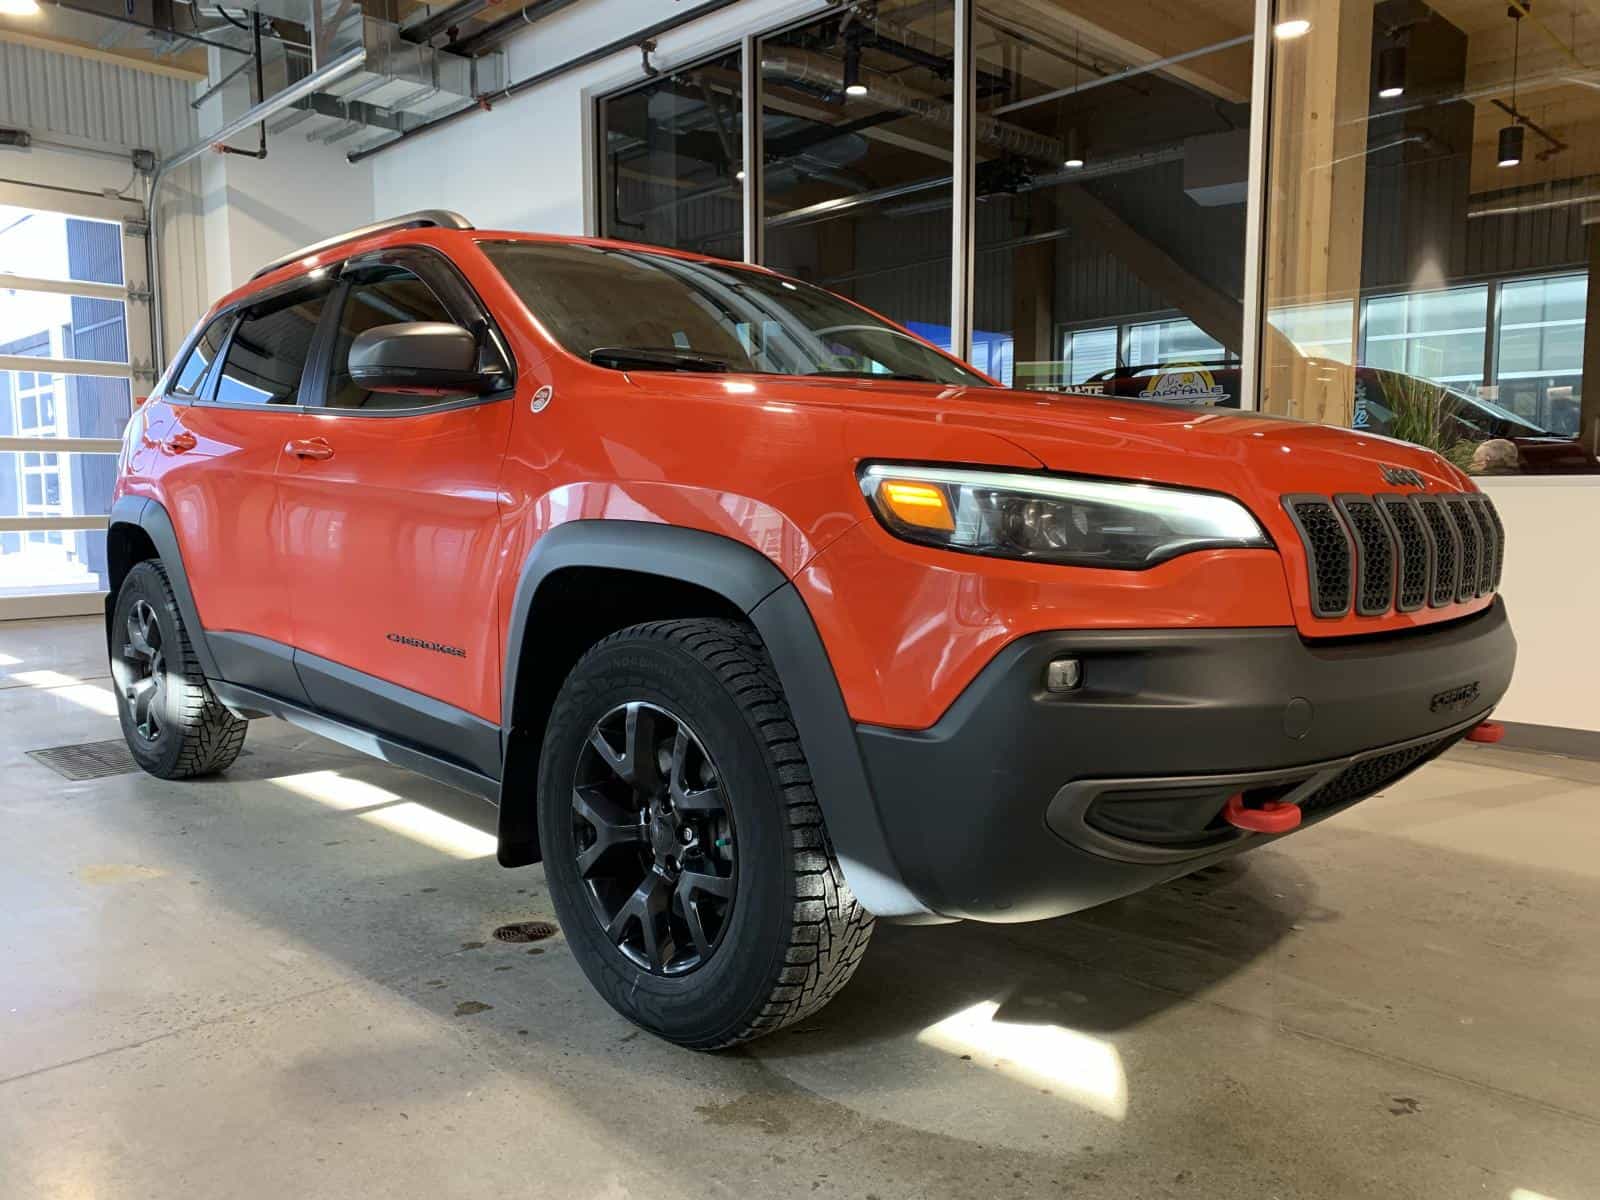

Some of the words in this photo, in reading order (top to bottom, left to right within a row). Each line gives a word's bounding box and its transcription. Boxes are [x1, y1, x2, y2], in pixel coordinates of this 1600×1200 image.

[1140, 385, 1223, 398] CAPITALE
[1379, 464, 1424, 489] Jeep
[386, 633, 466, 657] CHEROKEE
